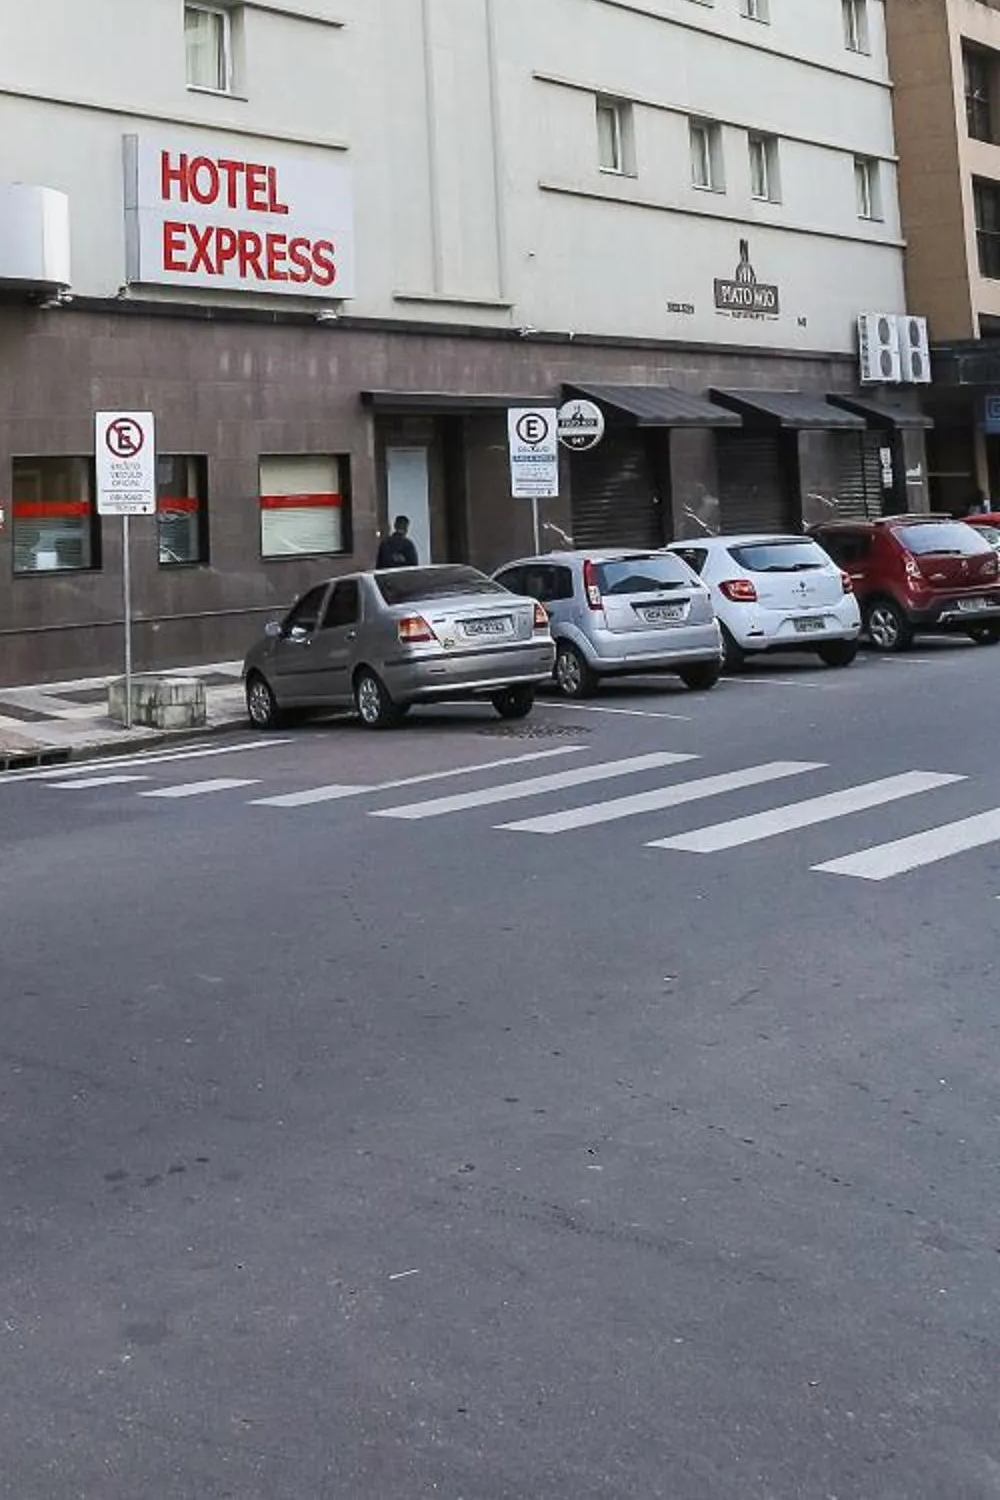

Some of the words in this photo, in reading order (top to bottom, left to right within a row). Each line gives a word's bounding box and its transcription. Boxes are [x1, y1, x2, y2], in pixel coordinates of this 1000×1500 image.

[161, 150, 289, 214] HOTEL
[163, 220, 337, 287] EXPRESS
[526, 419, 538, 438] E
